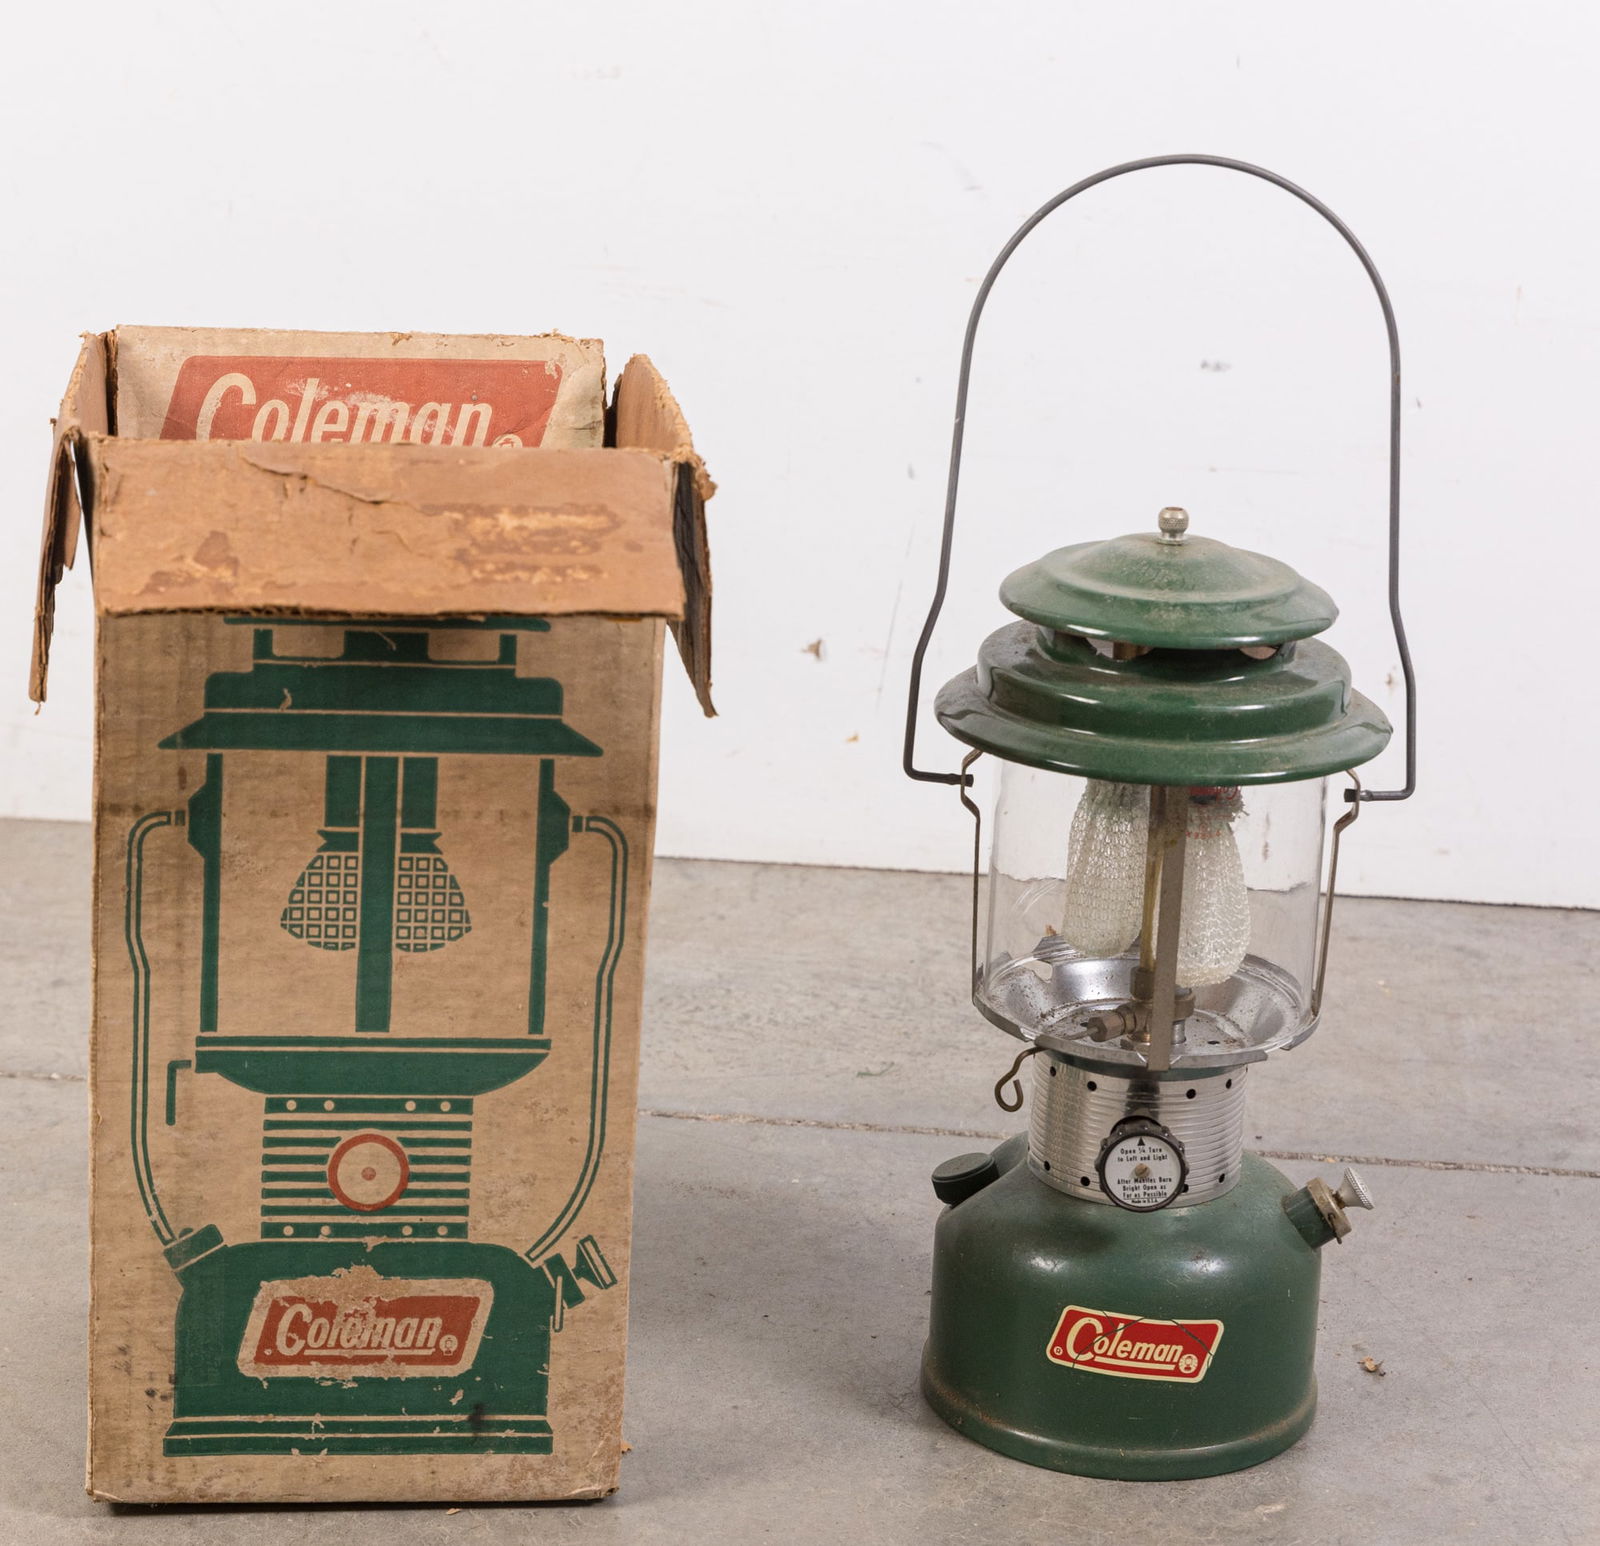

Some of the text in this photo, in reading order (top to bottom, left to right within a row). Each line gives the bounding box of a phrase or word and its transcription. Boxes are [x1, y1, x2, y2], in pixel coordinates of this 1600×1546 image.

[196, 372, 493, 447] Coleman
[275, 1303, 442, 1355] Coleman
[1065, 1316, 1184, 1363] Coleman
